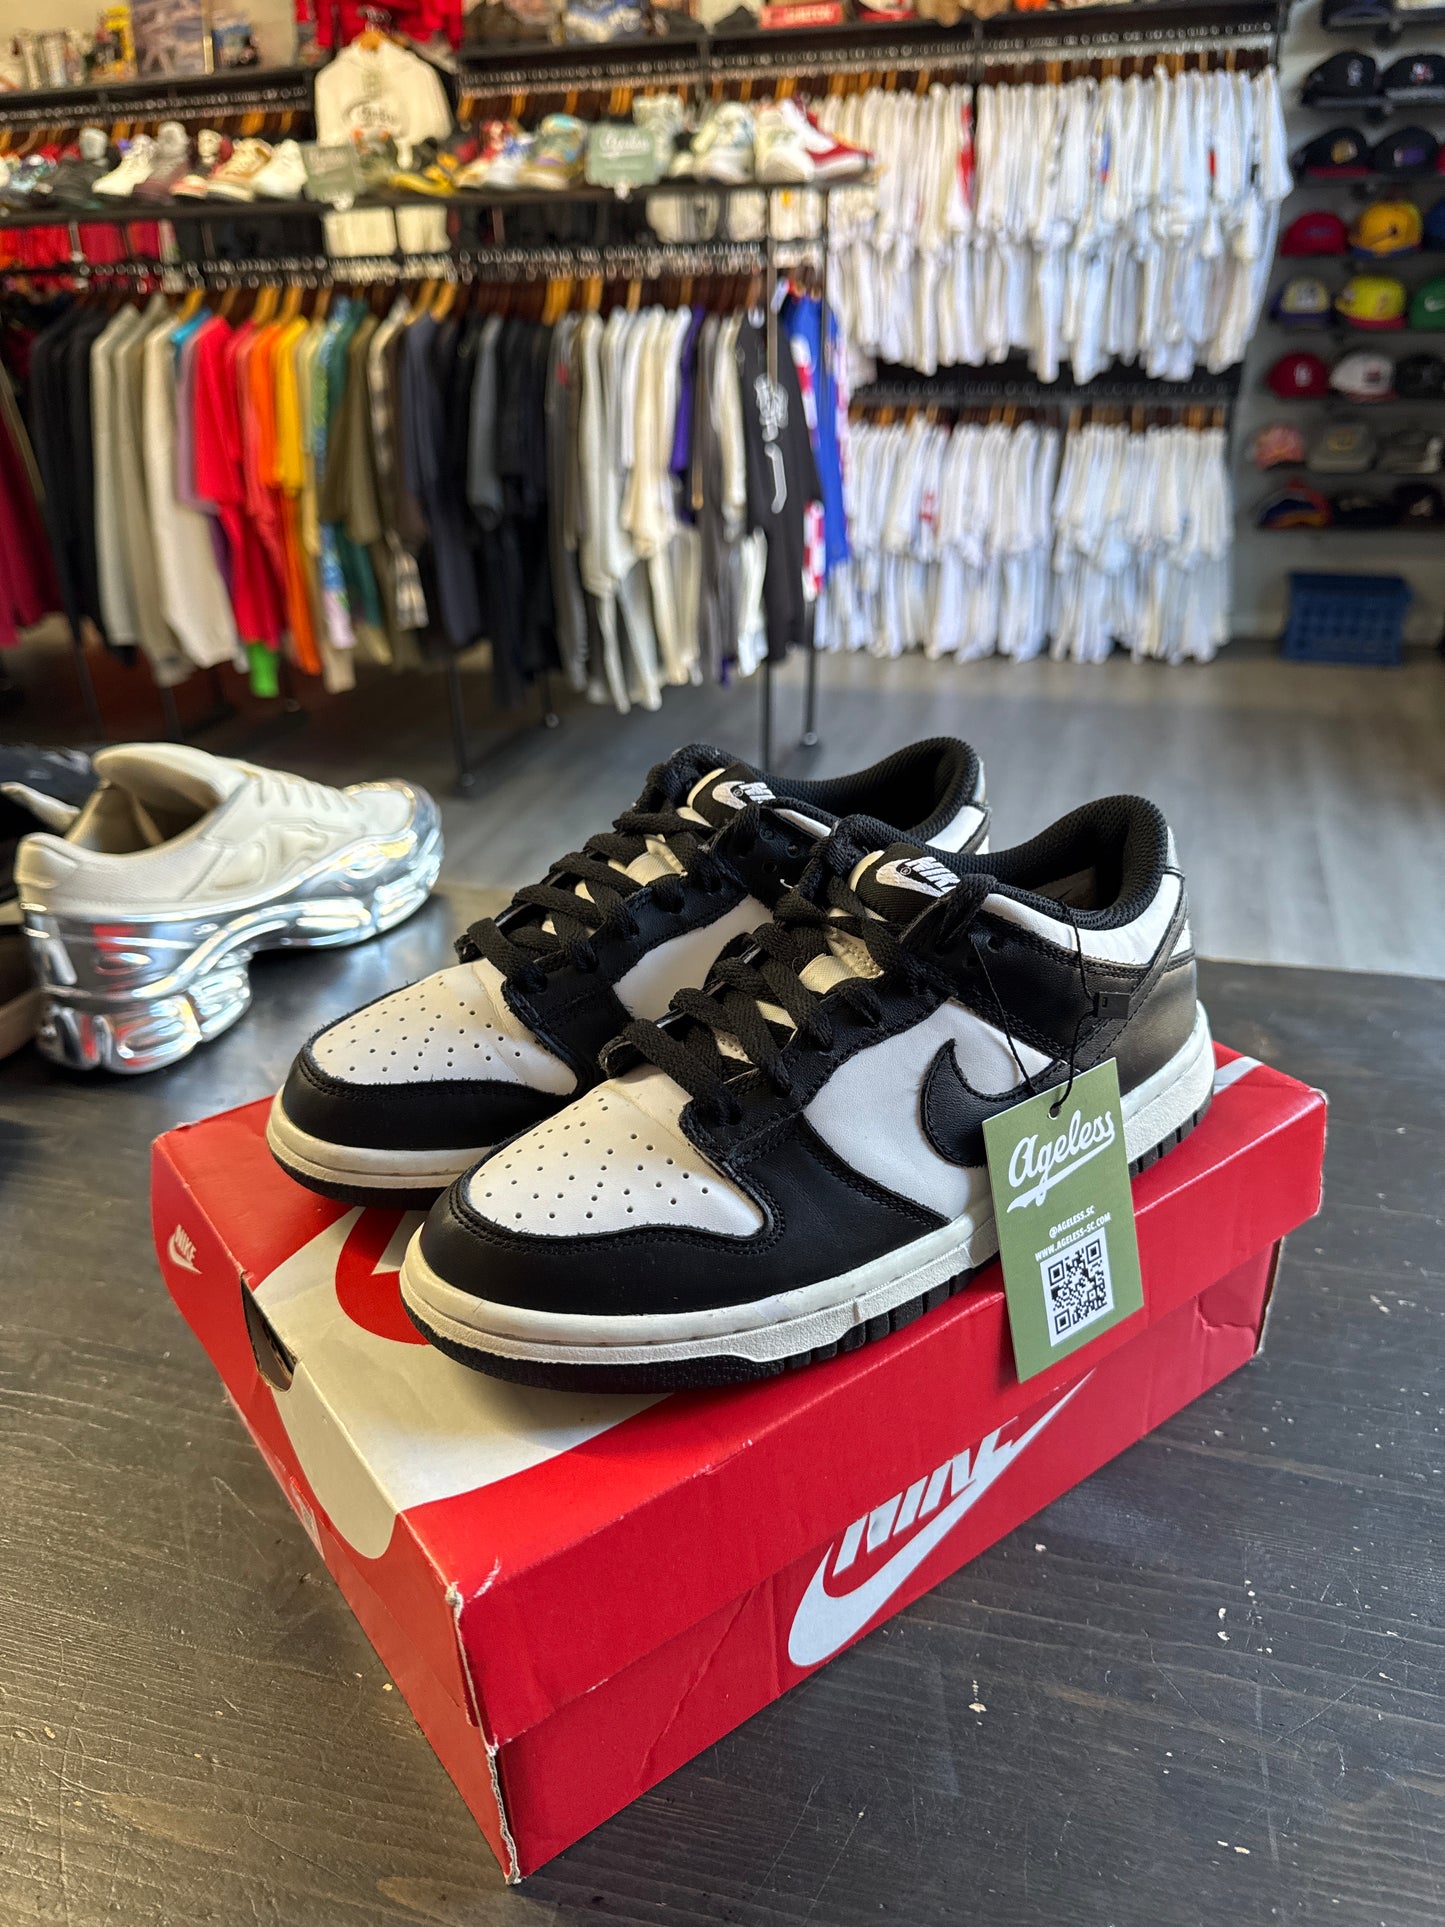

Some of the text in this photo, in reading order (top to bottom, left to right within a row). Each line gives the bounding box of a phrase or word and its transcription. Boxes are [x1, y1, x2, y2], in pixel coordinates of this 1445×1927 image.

[1008, 1109, 1115, 1206] Ageless
[1035, 1211, 1111, 1262] WWW.AGELESS-SC.COM
[1049, 1205, 1095, 1239] @AGELESS.SC
